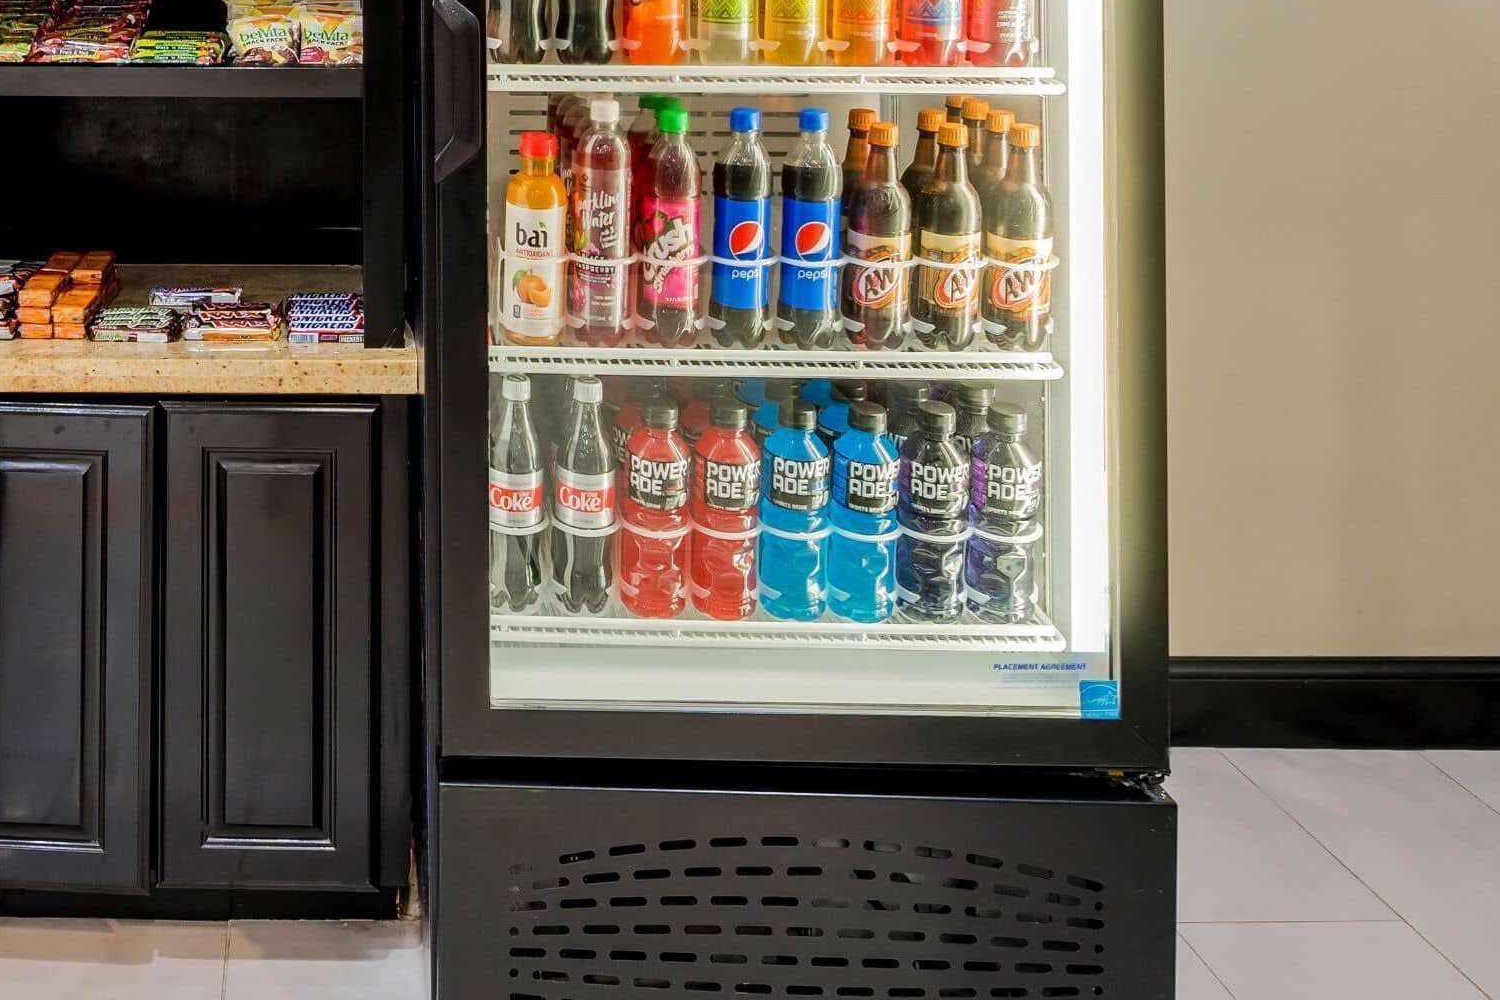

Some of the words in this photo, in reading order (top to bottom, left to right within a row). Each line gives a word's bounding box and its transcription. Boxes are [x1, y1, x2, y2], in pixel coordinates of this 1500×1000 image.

[516, 221, 548, 247] bai
[631, 455, 688, 481] POWER
[773, 456, 831, 479] POWER
[910, 460, 970, 483] POWER
[988, 461, 1042, 484] POW
[630, 471, 663, 496] ADE
[705, 478, 744, 499] ADE
[772, 473, 810, 496] ADE
[848, 478, 887, 499] ADE
[910, 478, 949, 500] ADE
[987, 481, 1029, 500] ADE
[490, 487, 533, 511] Coke
[559, 487, 601, 512] Coke
[993, 663, 1038, 672] PLACEMENT
[1040, 663, 1087, 672] AGREEMENT
